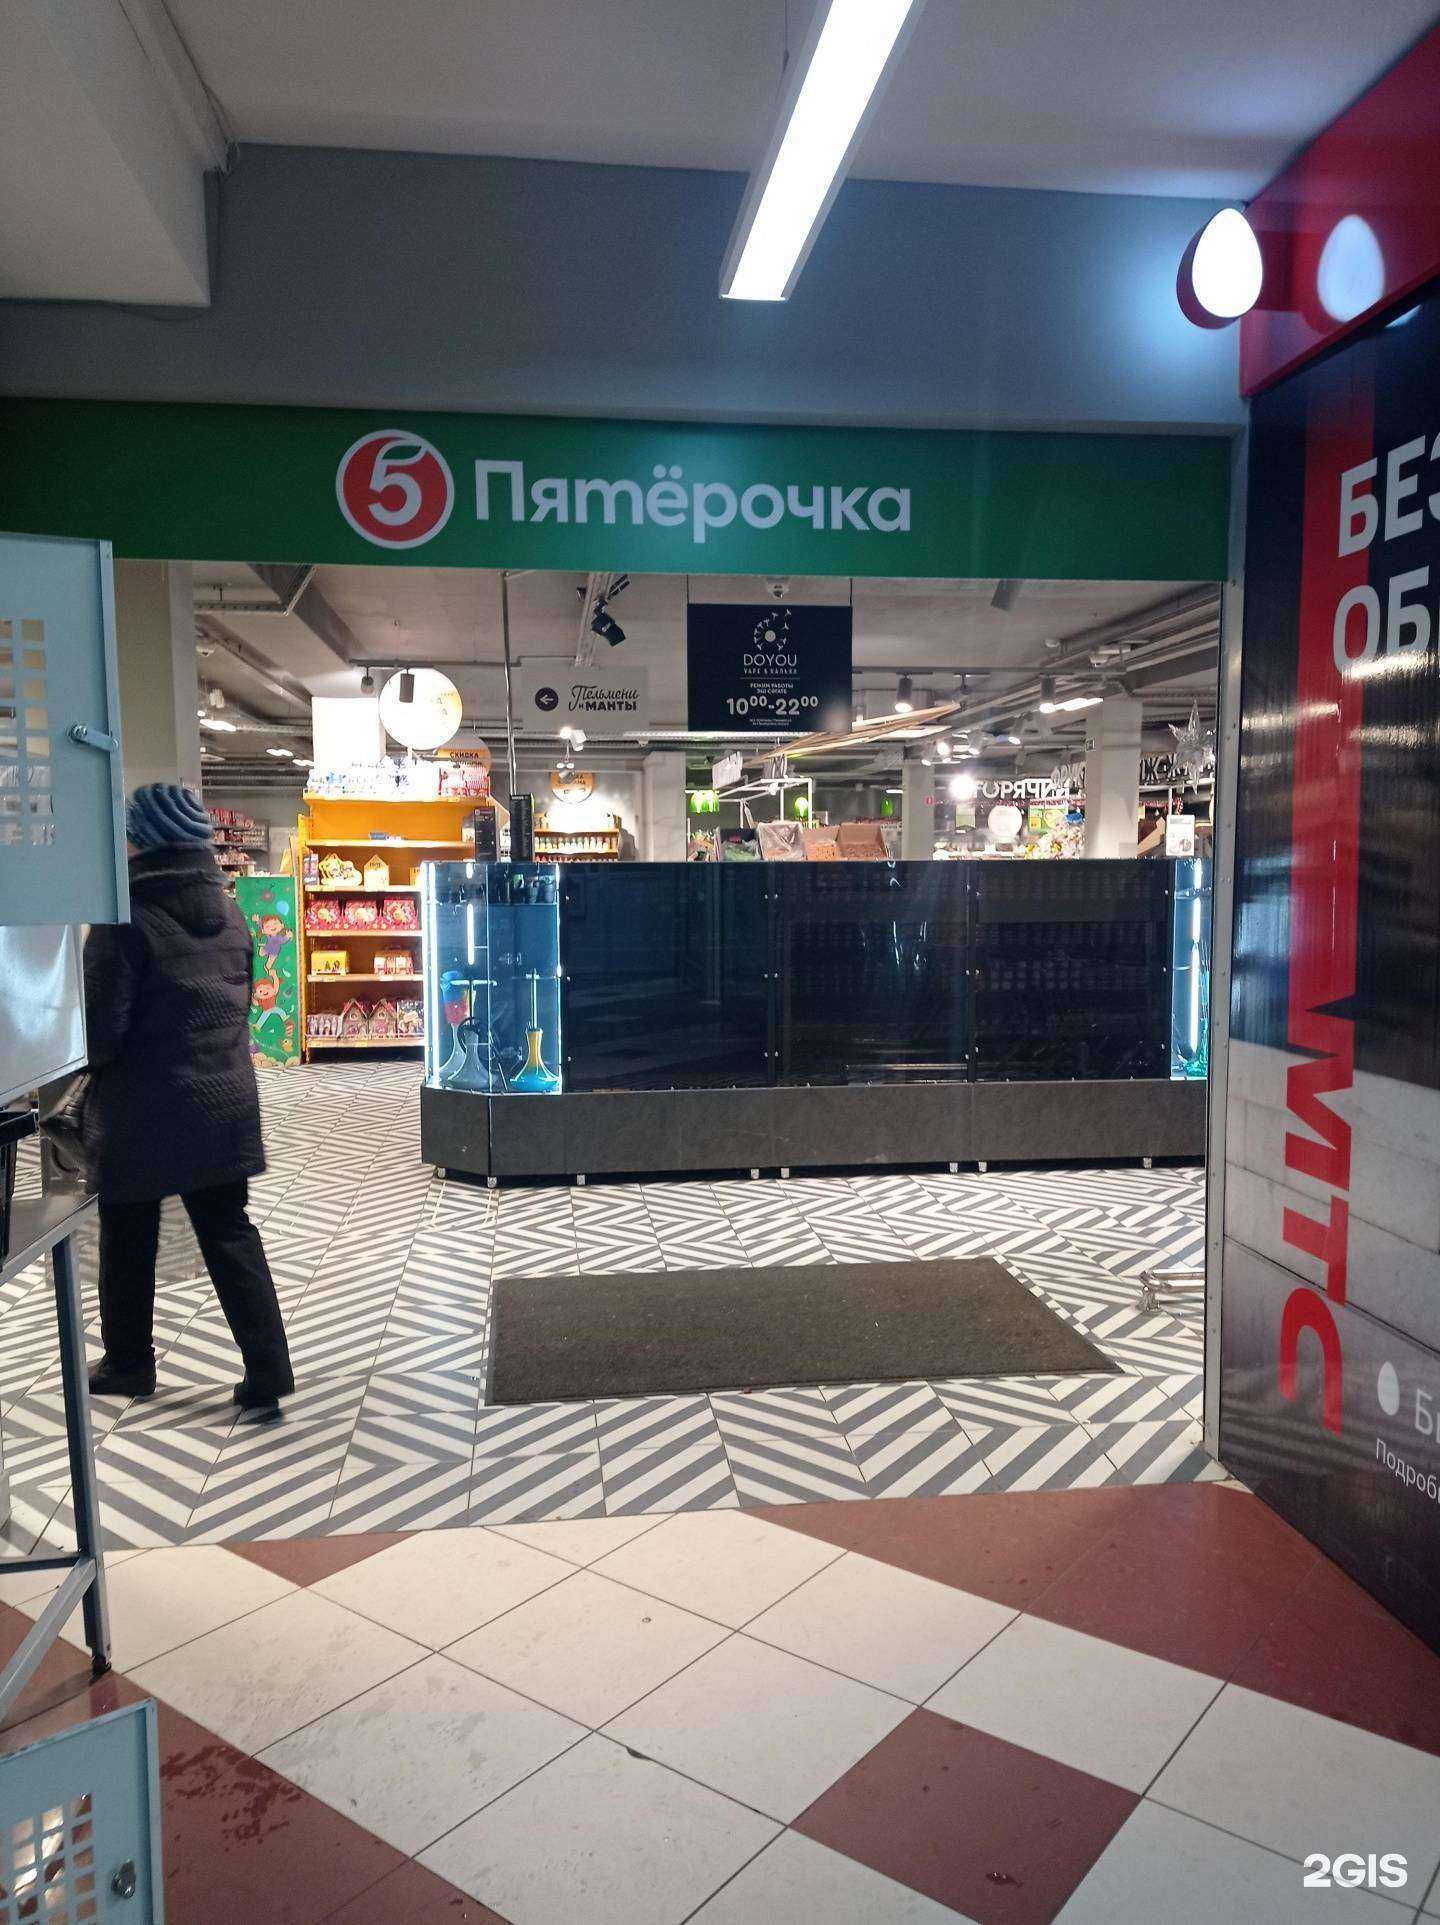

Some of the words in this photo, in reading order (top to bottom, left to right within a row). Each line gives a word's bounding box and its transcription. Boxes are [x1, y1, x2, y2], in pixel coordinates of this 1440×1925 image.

[368, 438, 426, 526] 5
[474, 459, 911, 543] Пятёрочка
[1333, 565, 1440, 677] ОБ
[743, 653, 797, 667] DOYOU
[568, 685, 639, 711] Пельмени
[585, 701, 637, 711] МАНТЫ
[1376, 1437, 1440, 1504] Подроб
